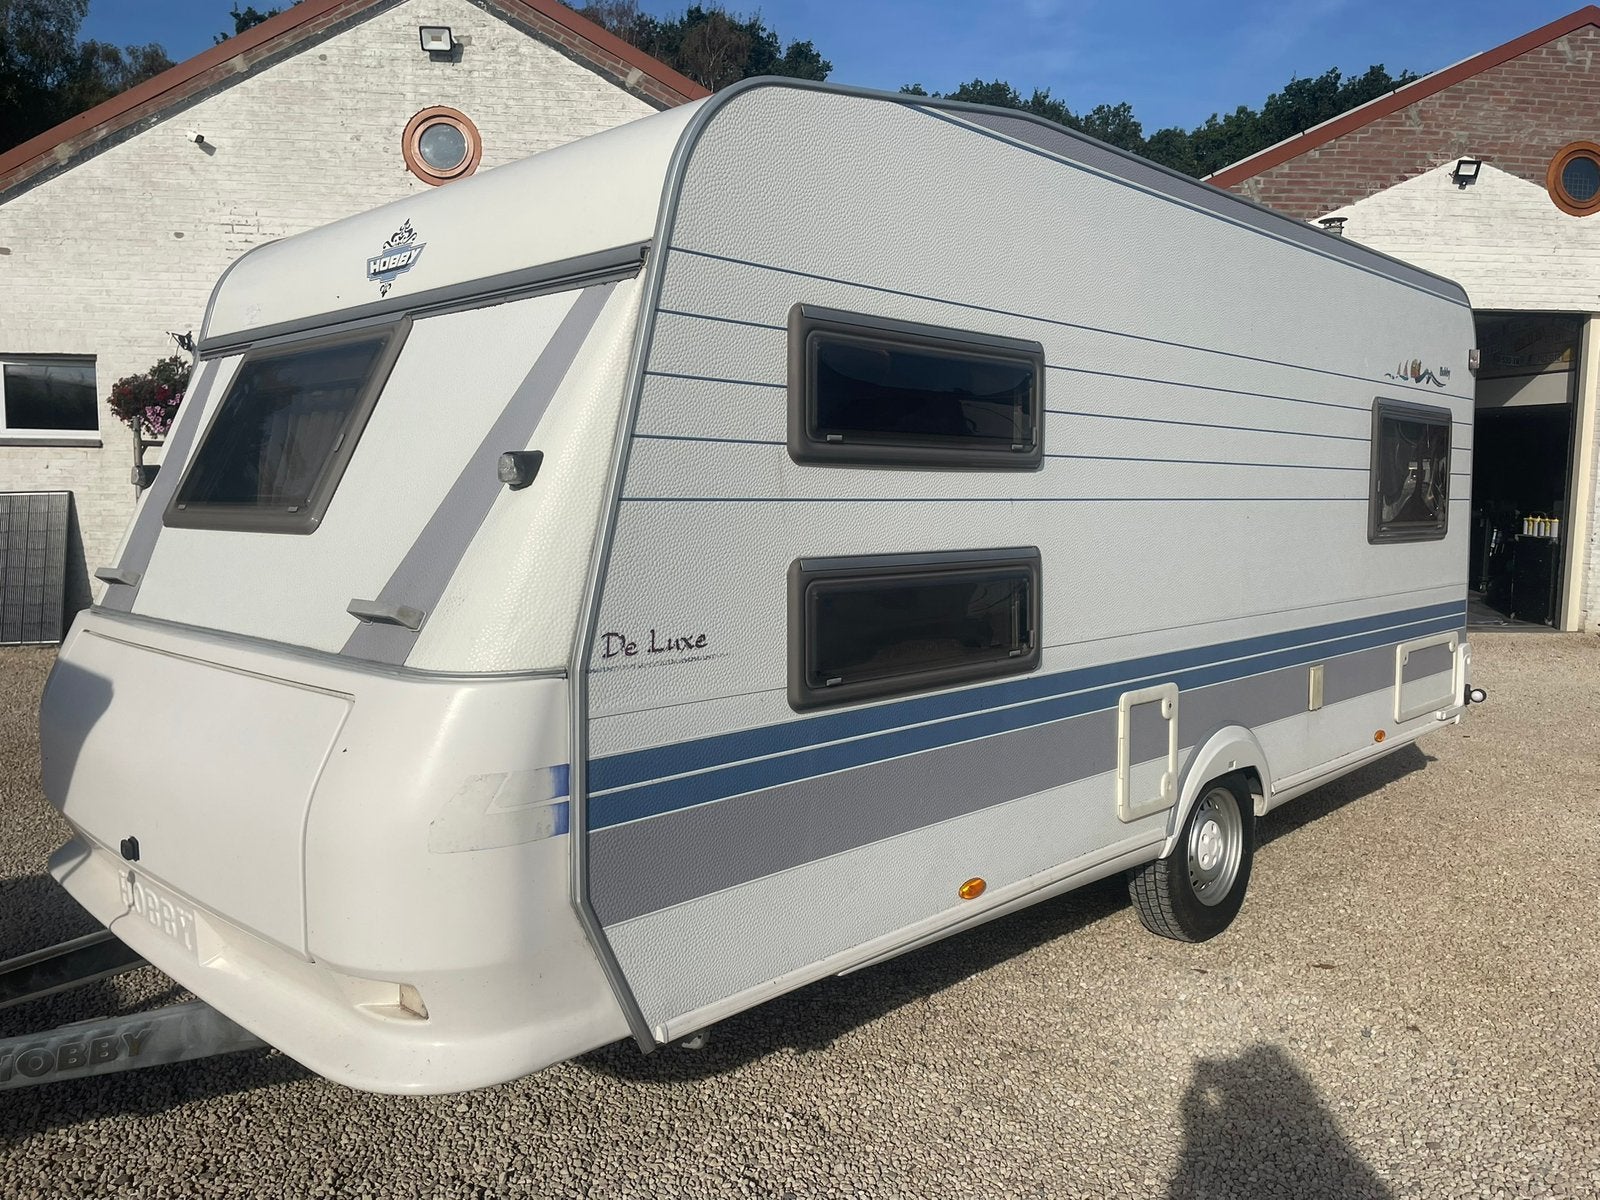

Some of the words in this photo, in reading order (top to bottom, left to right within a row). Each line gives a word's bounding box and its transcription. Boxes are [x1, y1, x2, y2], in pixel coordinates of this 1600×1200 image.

[369, 247, 422, 273] HOBBY
[600, 631, 638, 658] De
[647, 629, 708, 653] Luxe
[118, 868, 194, 952] HOBBY
